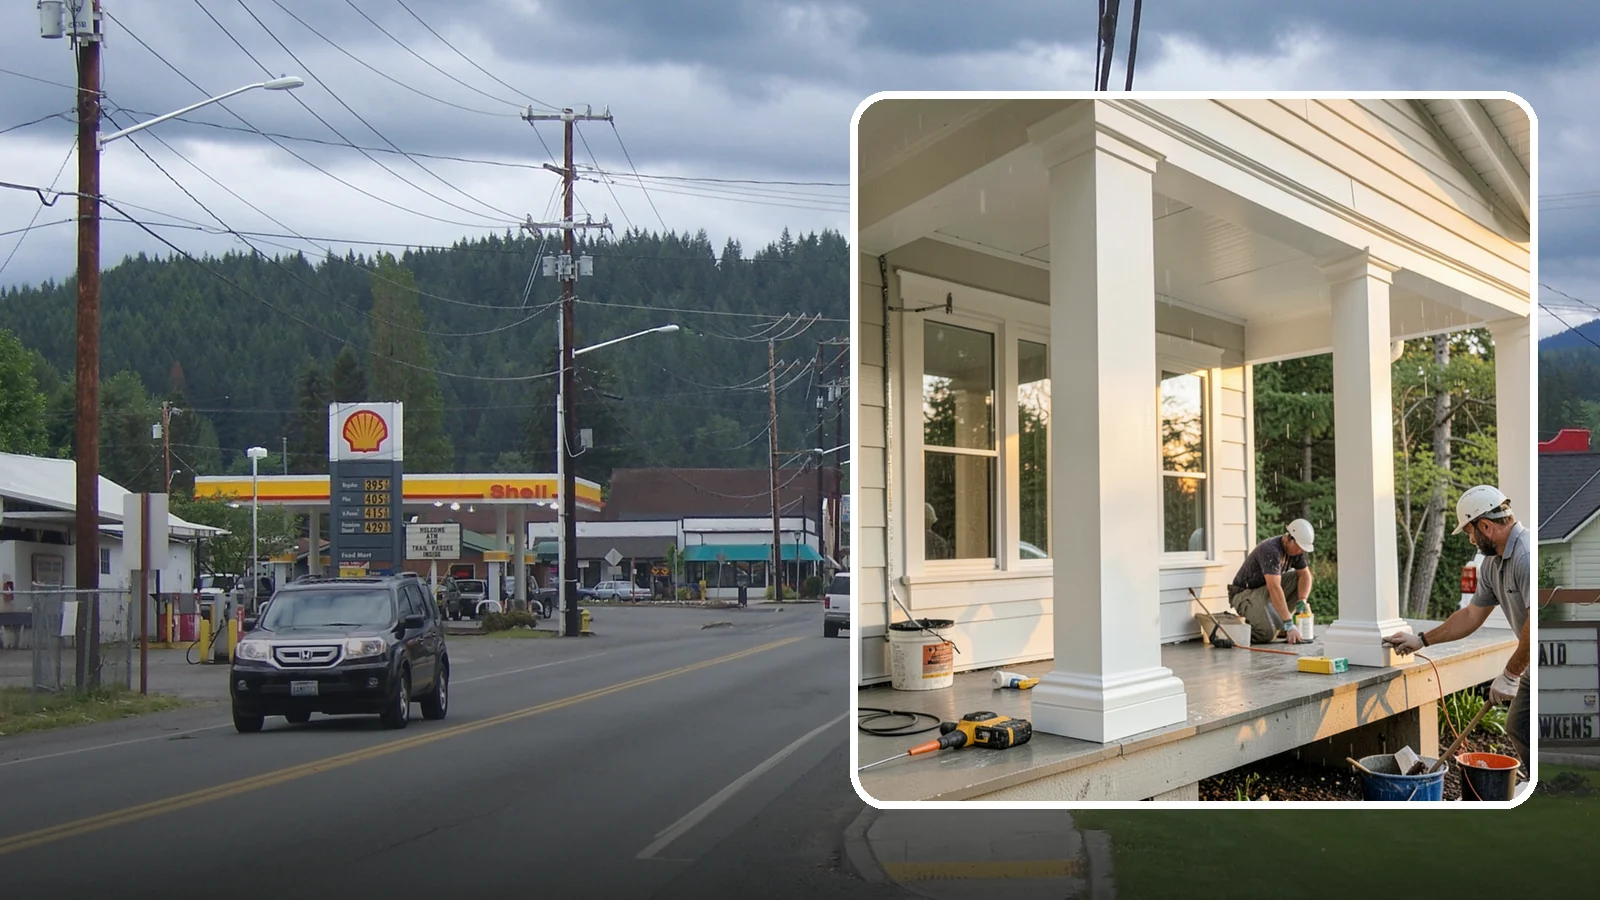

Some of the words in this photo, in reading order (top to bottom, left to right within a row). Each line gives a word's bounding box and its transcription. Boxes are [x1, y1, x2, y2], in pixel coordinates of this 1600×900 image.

[366, 480, 383, 490] 395
[490, 484, 547, 499] Shell
[366, 494, 383, 504] 405
[366, 508, 383, 518] 415
[366, 522, 383, 532] 429
